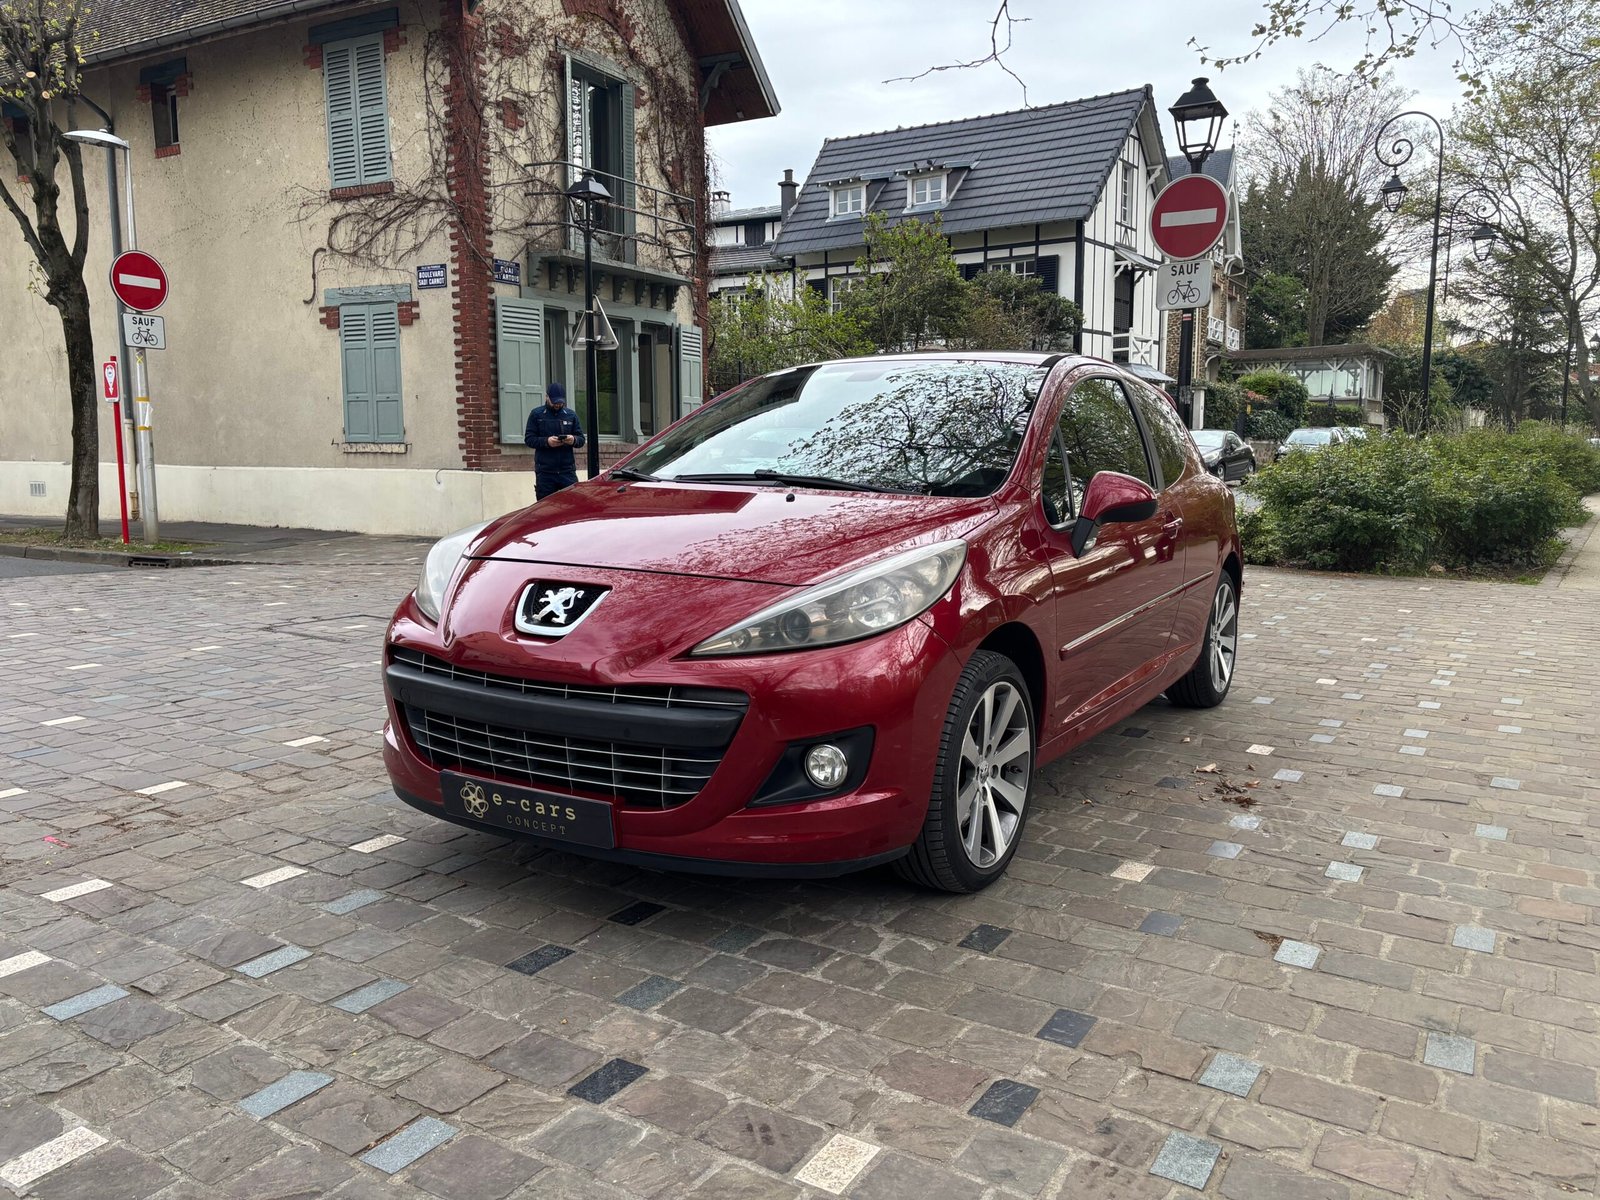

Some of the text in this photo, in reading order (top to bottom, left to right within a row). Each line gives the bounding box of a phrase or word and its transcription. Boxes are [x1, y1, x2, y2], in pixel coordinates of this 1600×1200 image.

[419, 270, 444, 278] BOULEVARD
[1171, 263, 1200, 276] SAUF
[428, 277, 445, 285] CARNOT
[132, 316, 155, 326] SAUF
[492, 793, 576, 820] e-cars
[506, 815, 566, 835] CONCEPT
